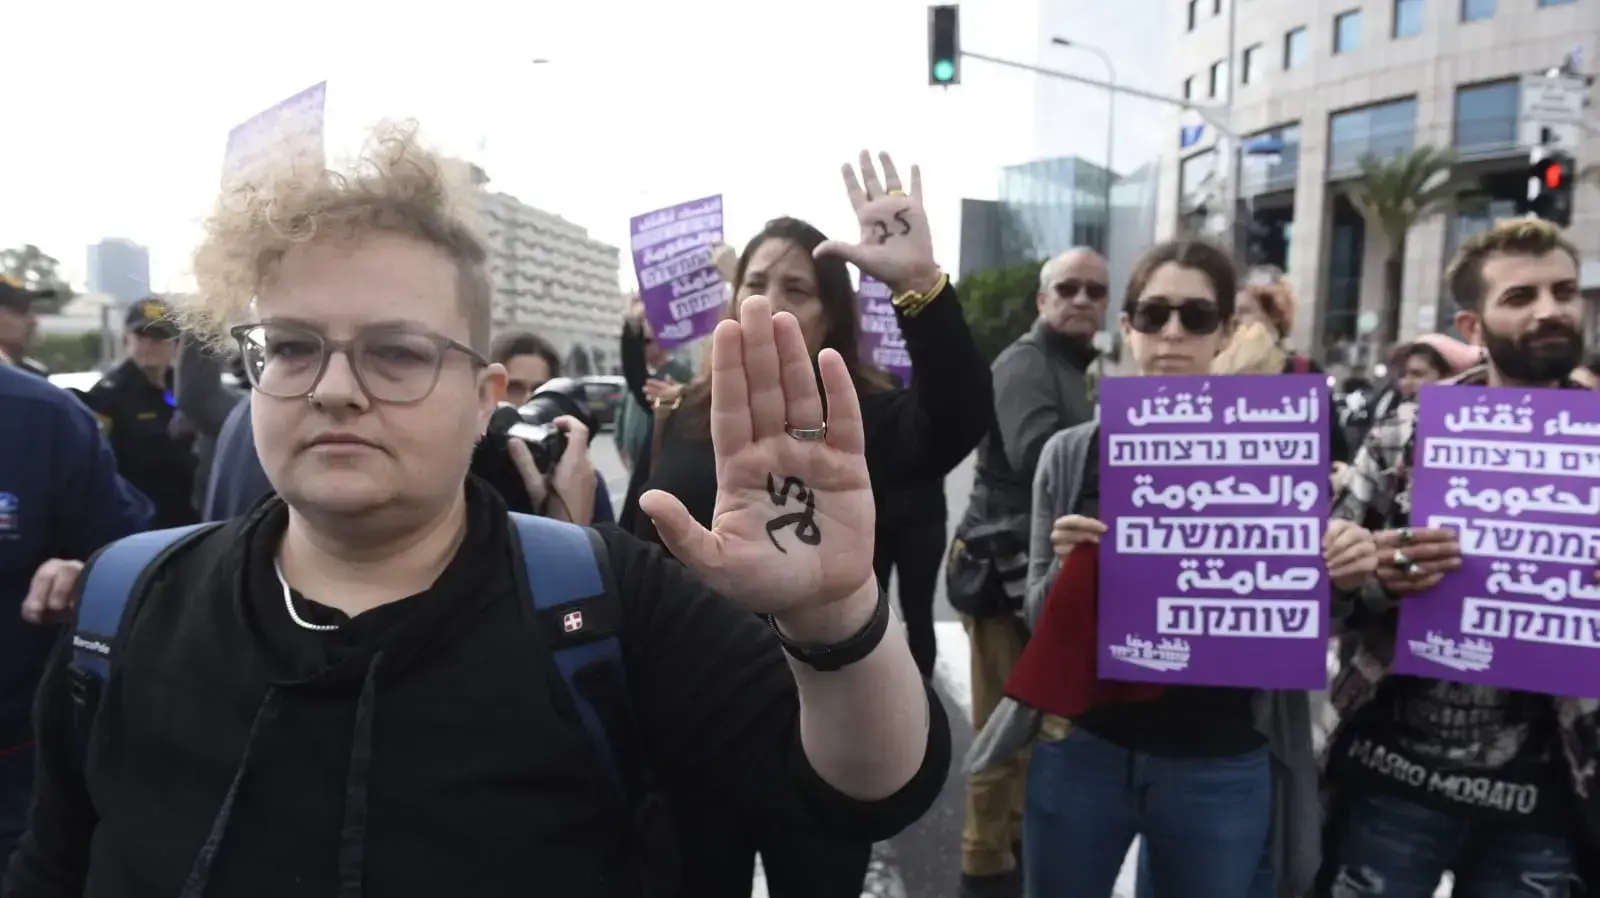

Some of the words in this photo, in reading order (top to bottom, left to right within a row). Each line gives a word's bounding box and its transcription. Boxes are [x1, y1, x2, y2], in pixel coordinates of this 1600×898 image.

[871, 207, 911, 245] 25
[1113, 440, 1227, 461] נרצחות
[1240, 439, 1314, 461] נשים
[1430, 445, 1546, 470] נרצחות
[1131, 474, 1319, 512] والحكومة
[1444, 476, 1600, 516] لحكومة
[766, 471, 822, 555] 25
[1126, 518, 1310, 549] והממשלה
[1177, 558, 1320, 595] صامتة
[1167, 605, 1310, 634] שותקת
[1427, 772, 1538, 814] MORATO
